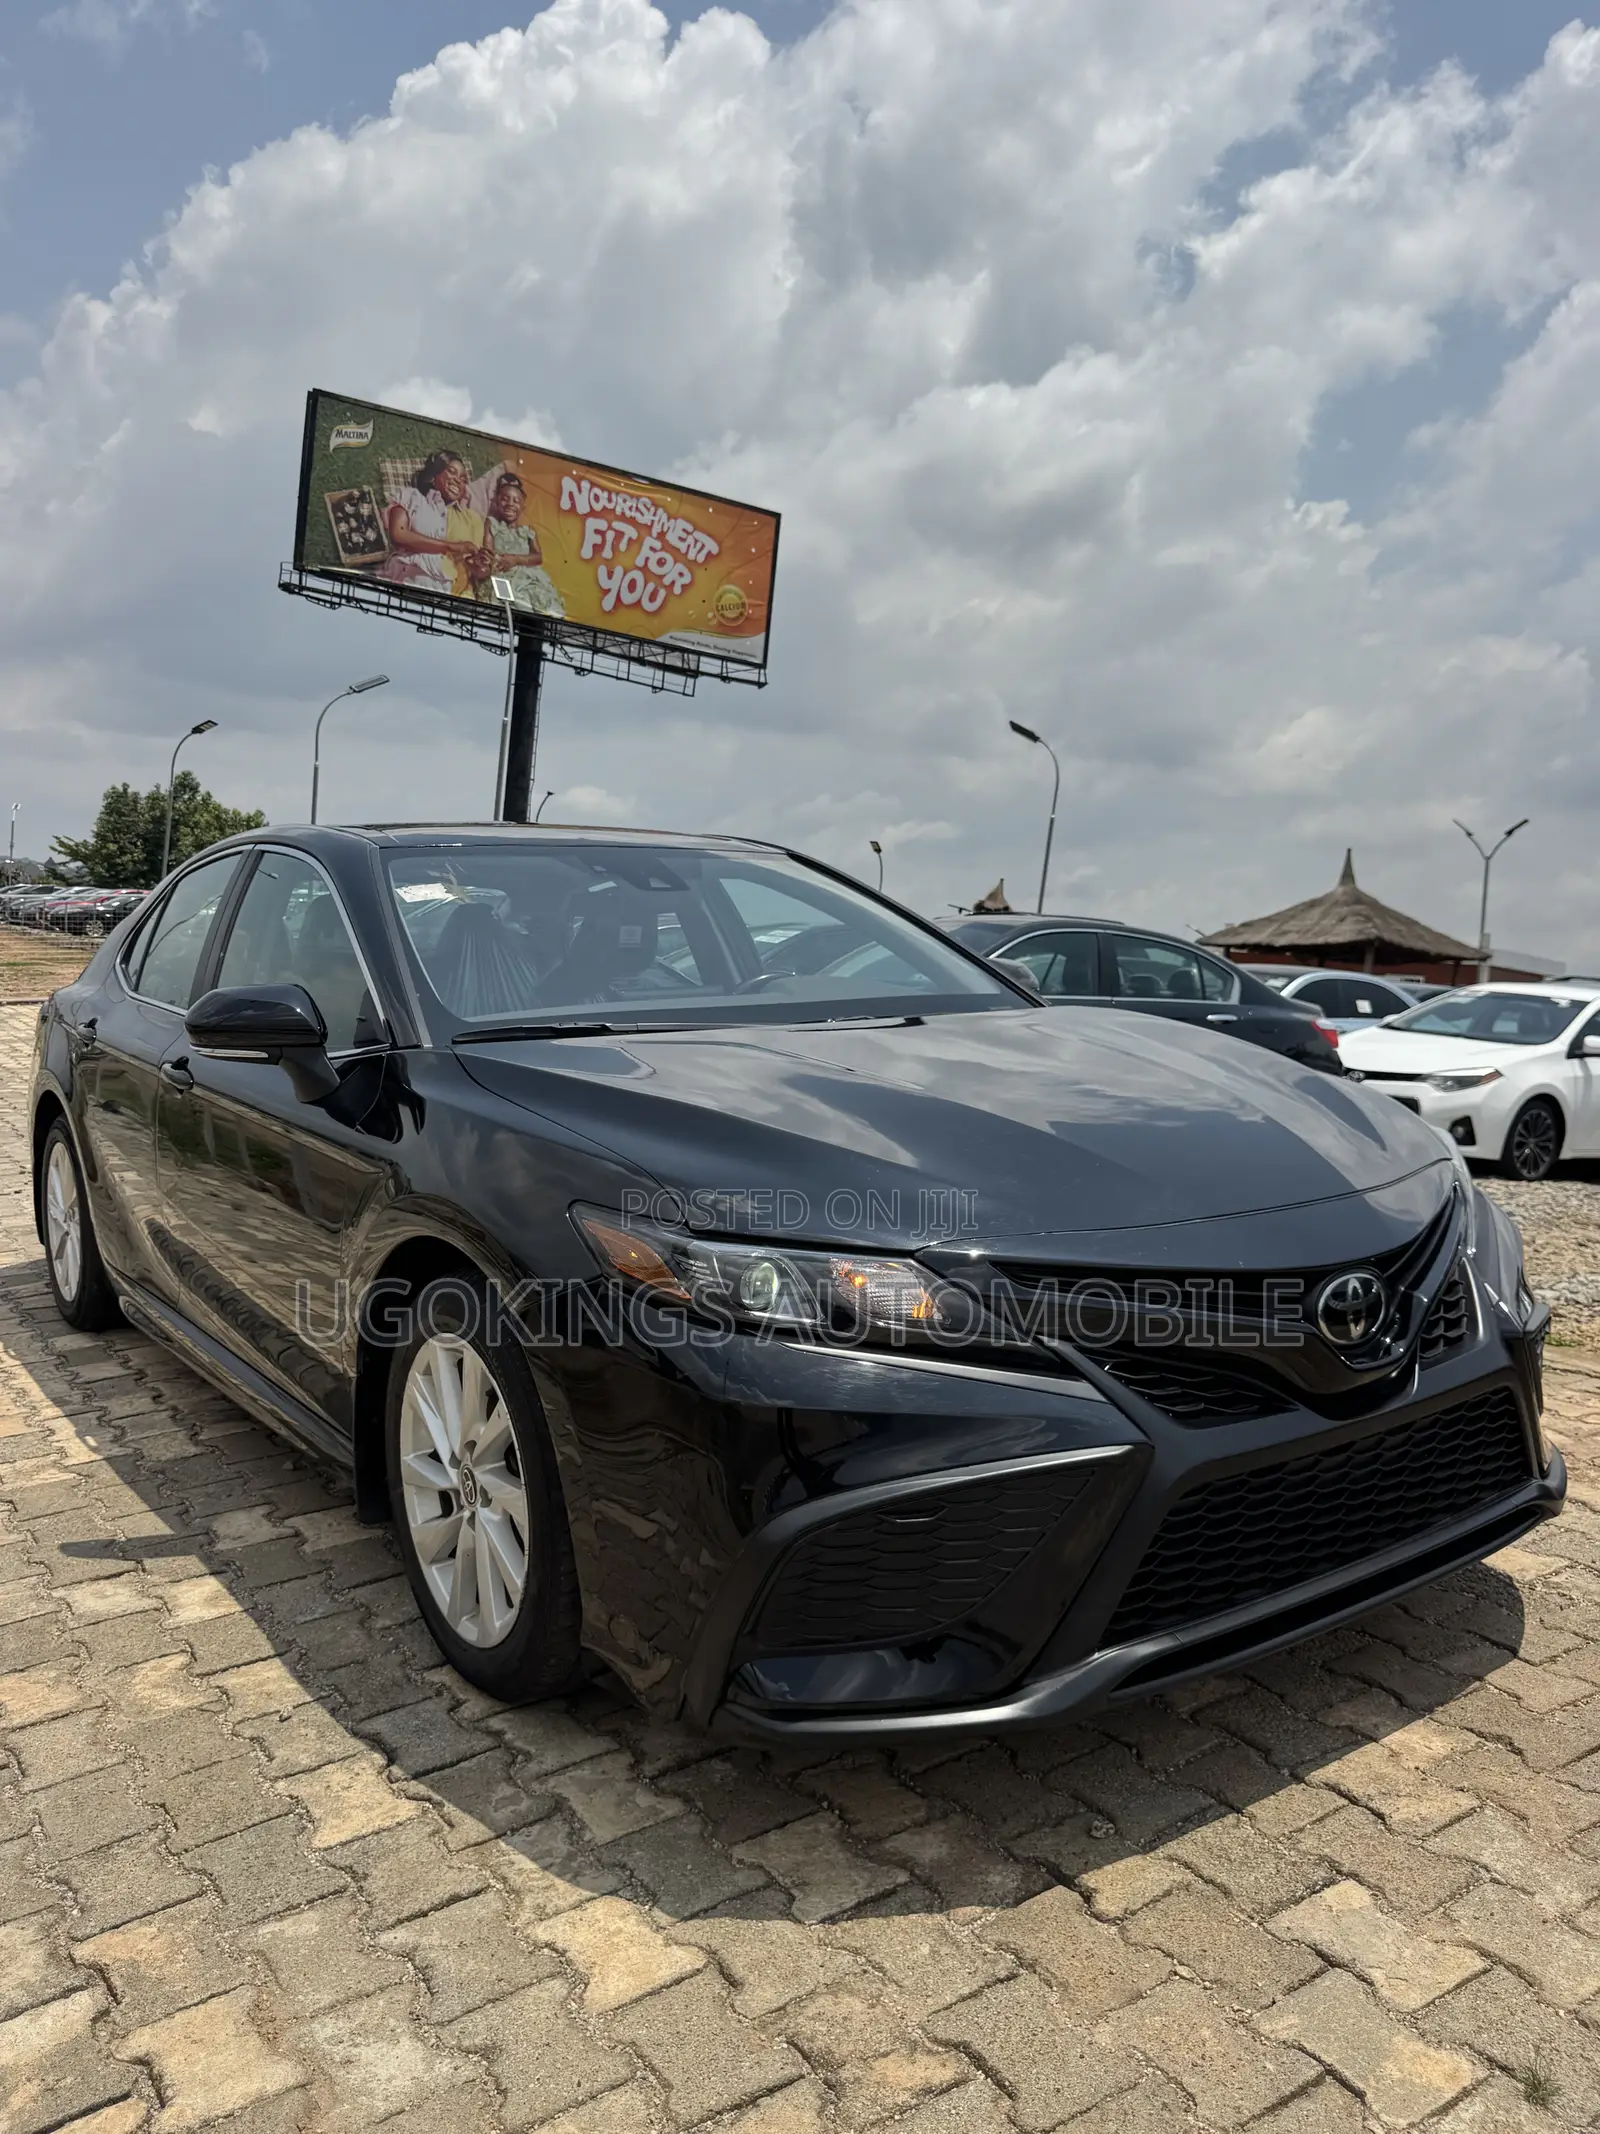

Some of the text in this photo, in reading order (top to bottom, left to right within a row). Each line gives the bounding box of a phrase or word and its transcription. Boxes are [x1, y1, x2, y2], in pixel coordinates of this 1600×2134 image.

[335, 428, 369, 440] MALTINA
[560, 476, 719, 563] NOURISHMENT
[580, 517, 692, 595] FIT FOR
[597, 564, 667, 612] YOU
